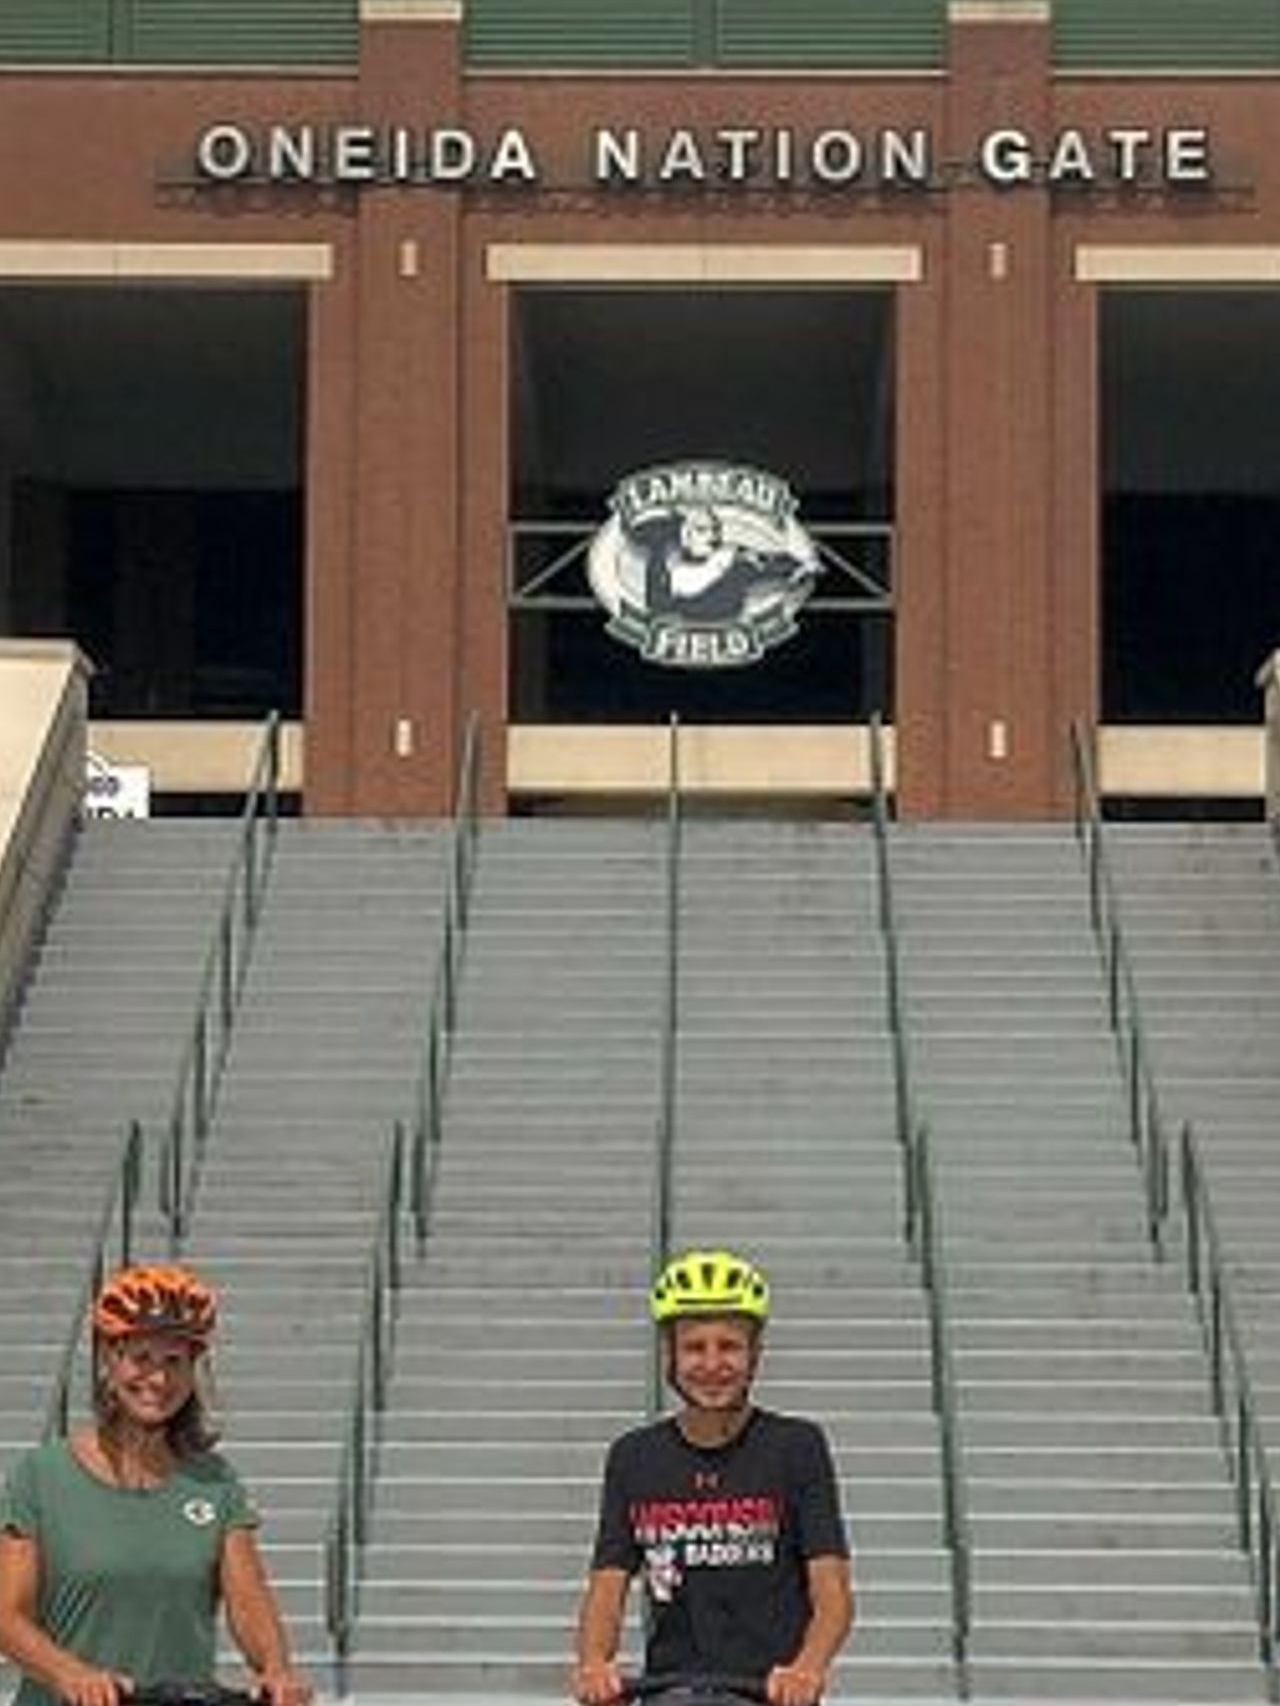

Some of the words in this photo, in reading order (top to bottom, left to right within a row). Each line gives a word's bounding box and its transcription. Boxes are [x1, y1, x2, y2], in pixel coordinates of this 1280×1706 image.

[198, 126, 536, 180] ONEIDA
[595, 129, 928, 181] NATION
[981, 129, 1209, 181] GATE
[655, 627, 752, 663] FIELD
